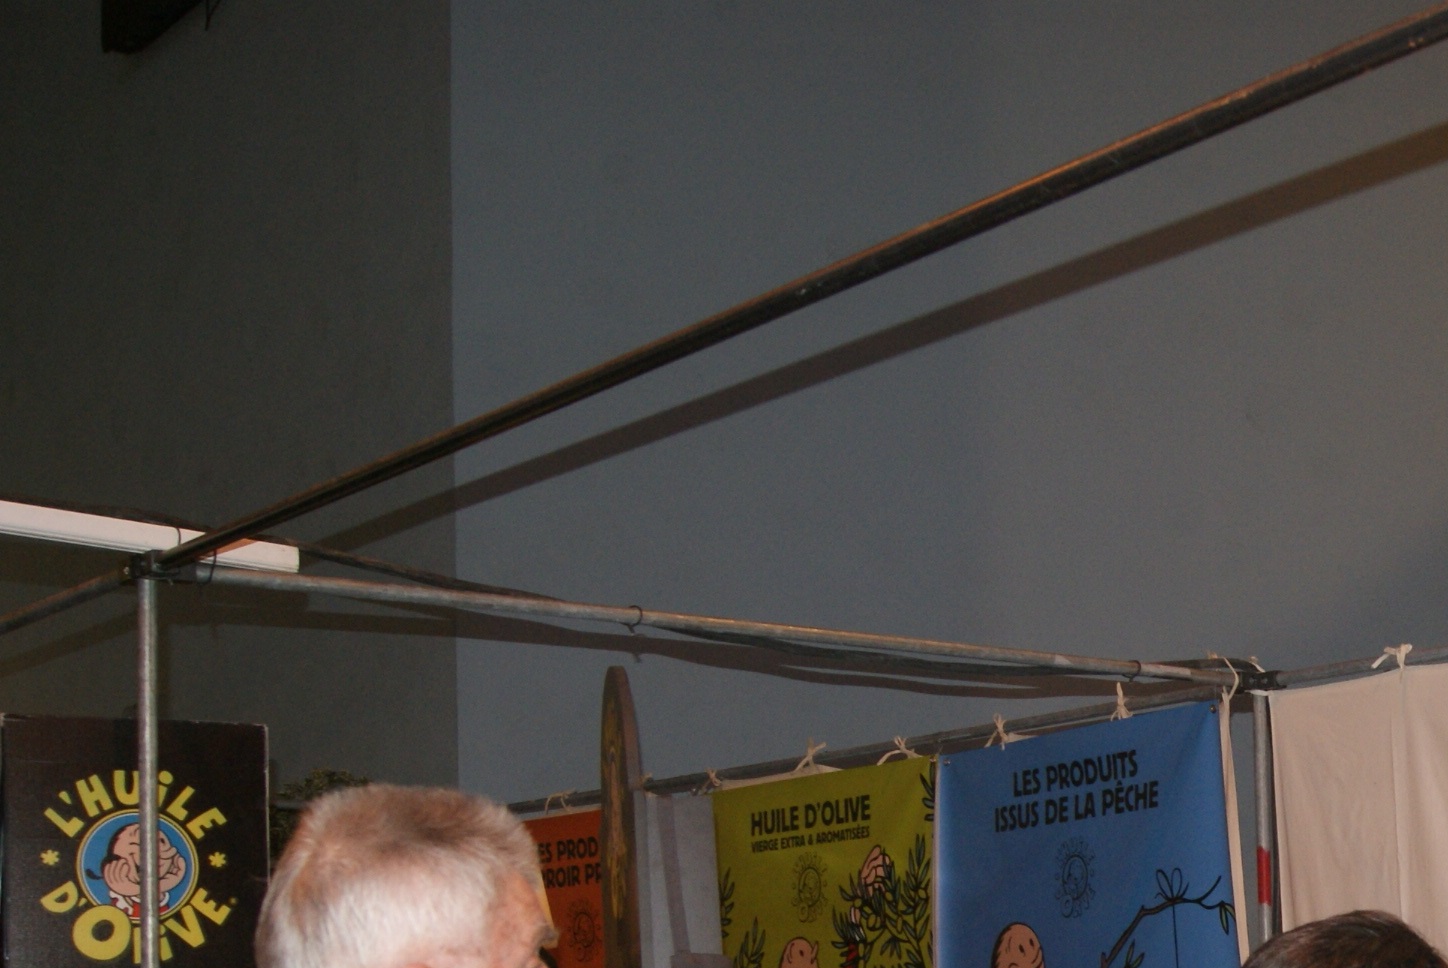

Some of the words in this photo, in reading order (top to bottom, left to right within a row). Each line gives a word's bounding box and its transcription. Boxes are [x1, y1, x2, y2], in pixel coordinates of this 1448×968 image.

[1013, 768, 1041, 797] LES
[1046, 750, 1138, 791] PRODUITS
[751, 806, 799, 836] HUILE
[804, 795, 871, 828] D'OLIVE
[995, 801, 1039, 832] ISSUS
[1045, 797, 1069, 825] DE
[1074, 792, 1096, 820] LA
[1102, 780, 1159, 816] PÊCHE
[538, 842, 552, 864] ES
[557, 836, 599, 860] PROD
[751, 838, 779, 853] VIERGE
[780, 835, 806, 849] EXTRA
[816, 825, 870, 844] AROMATISÉES
[542, 865, 580, 888] ROIR
